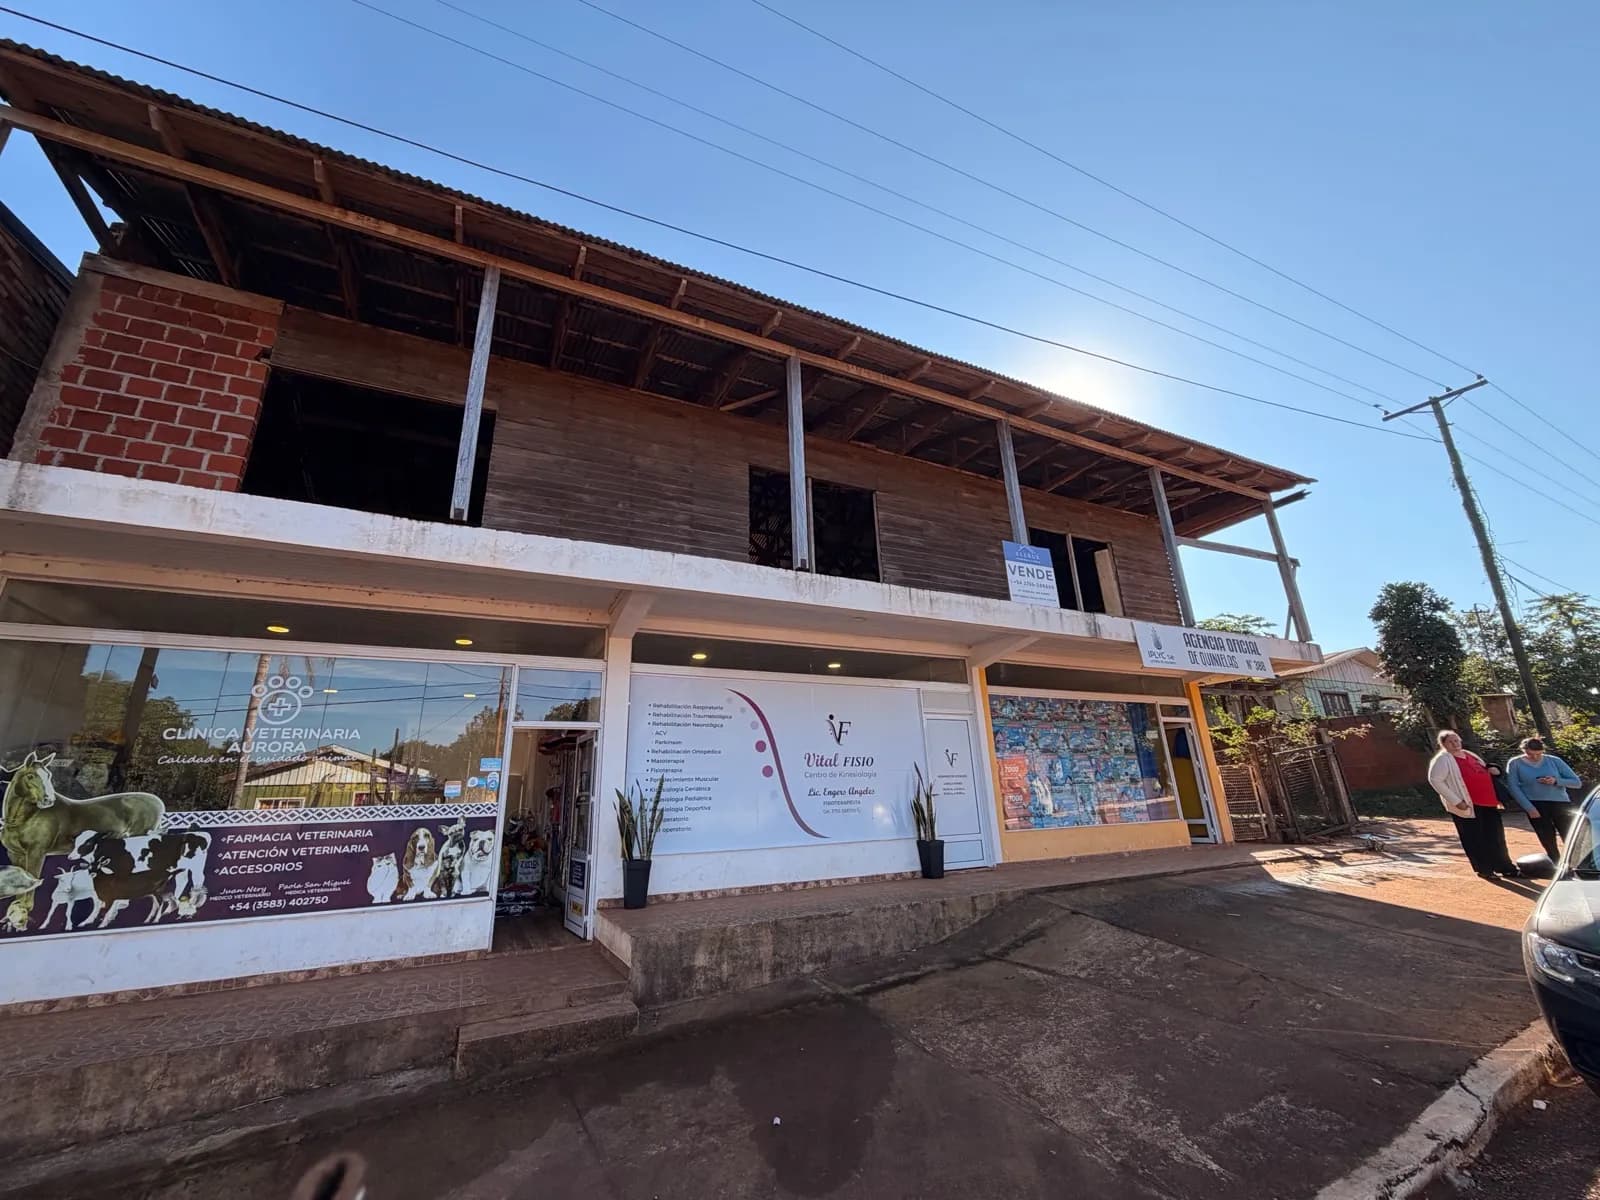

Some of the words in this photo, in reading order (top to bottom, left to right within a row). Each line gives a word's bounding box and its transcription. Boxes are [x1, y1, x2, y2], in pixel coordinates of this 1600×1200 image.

[1008, 564, 1054, 581] VENDE
[1183, 632, 1226, 652] AGENCIA
[1226, 638, 1261, 656] OFICIAL
[1188, 650, 1199, 664] DE
[1199, 651, 1240, 668] QUINIELAS
[162, 727, 240, 740] CLINICA
[247, 727, 361, 740] VETERINARIA
[226, 741, 307, 754] AURORA
[158, 754, 217, 765] Calidad
[256, 754, 309, 764] cuidado
[804, 752, 839, 767] Vital
[843, 756, 874, 767] FISIO
[828, 770, 838, 778] de
[226, 832, 292, 844] FARMACIA
[295, 829, 374, 841] VETERINARIA
[221, 846, 290, 861] ATENCIÓN
[292, 844, 370, 857] VETERINARIA
[218, 861, 303, 876] ACCESORIOS
[278, 882, 304, 890] Paola
[304, 881, 322, 889] San
[322, 878, 352, 888] Miguel
[229, 901, 250, 911] +54
[288, 895, 329, 906] 402750
